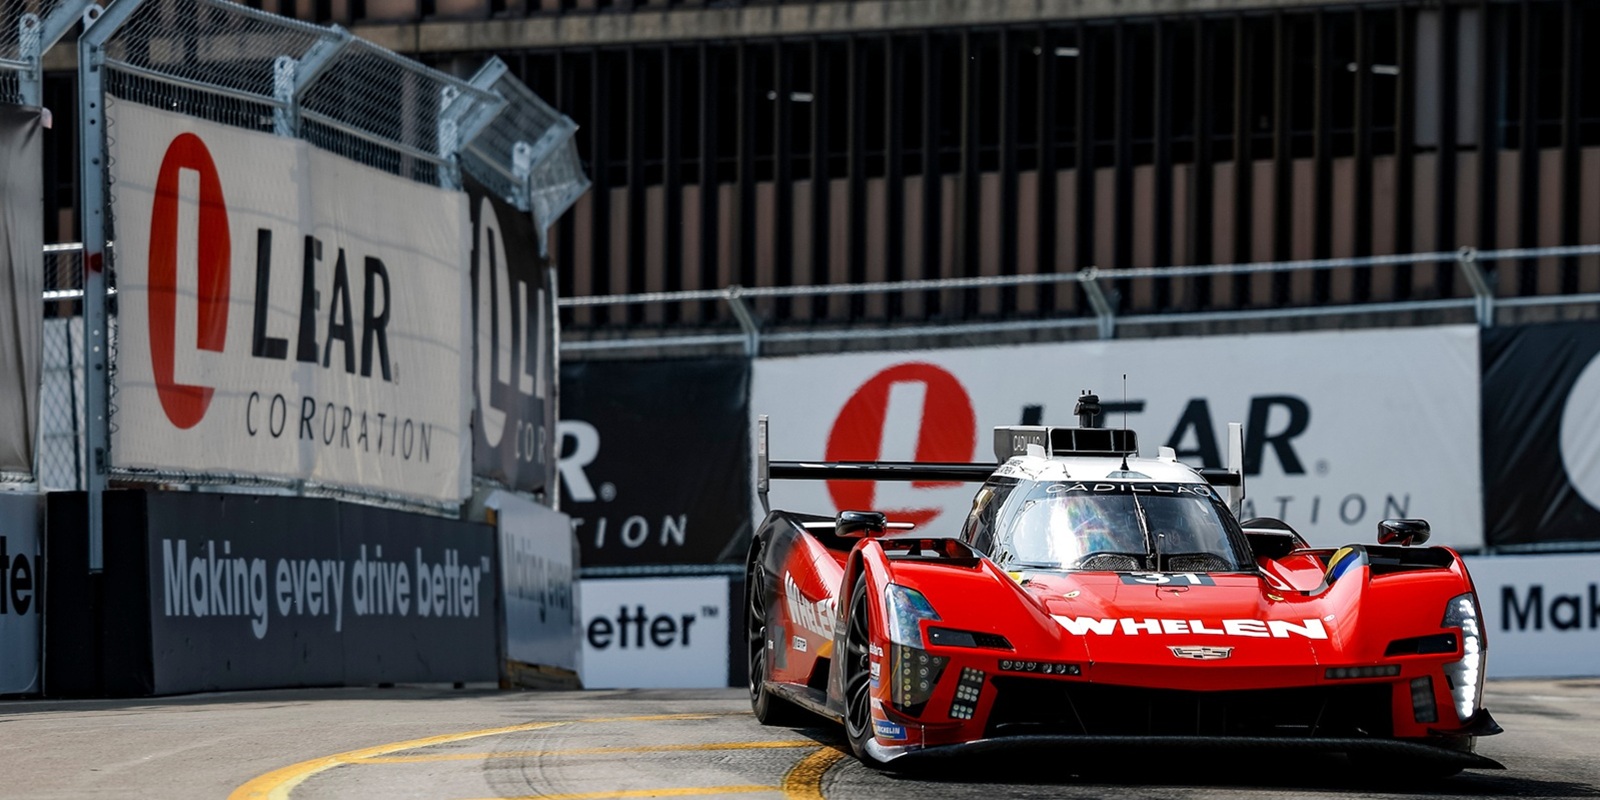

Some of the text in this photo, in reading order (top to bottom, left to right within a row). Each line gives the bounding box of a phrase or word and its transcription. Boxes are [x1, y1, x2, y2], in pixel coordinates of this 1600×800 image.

[252, 227, 392, 382] LEAR
[1046, 482, 1212, 497] CADILLAC
[163, 539, 268, 639] Making
[276, 558, 345, 632] every
[352, 544, 411, 616] drive
[1131, 572, 1203, 585] 31
[1049, 613, 1329, 640] WHELEN
